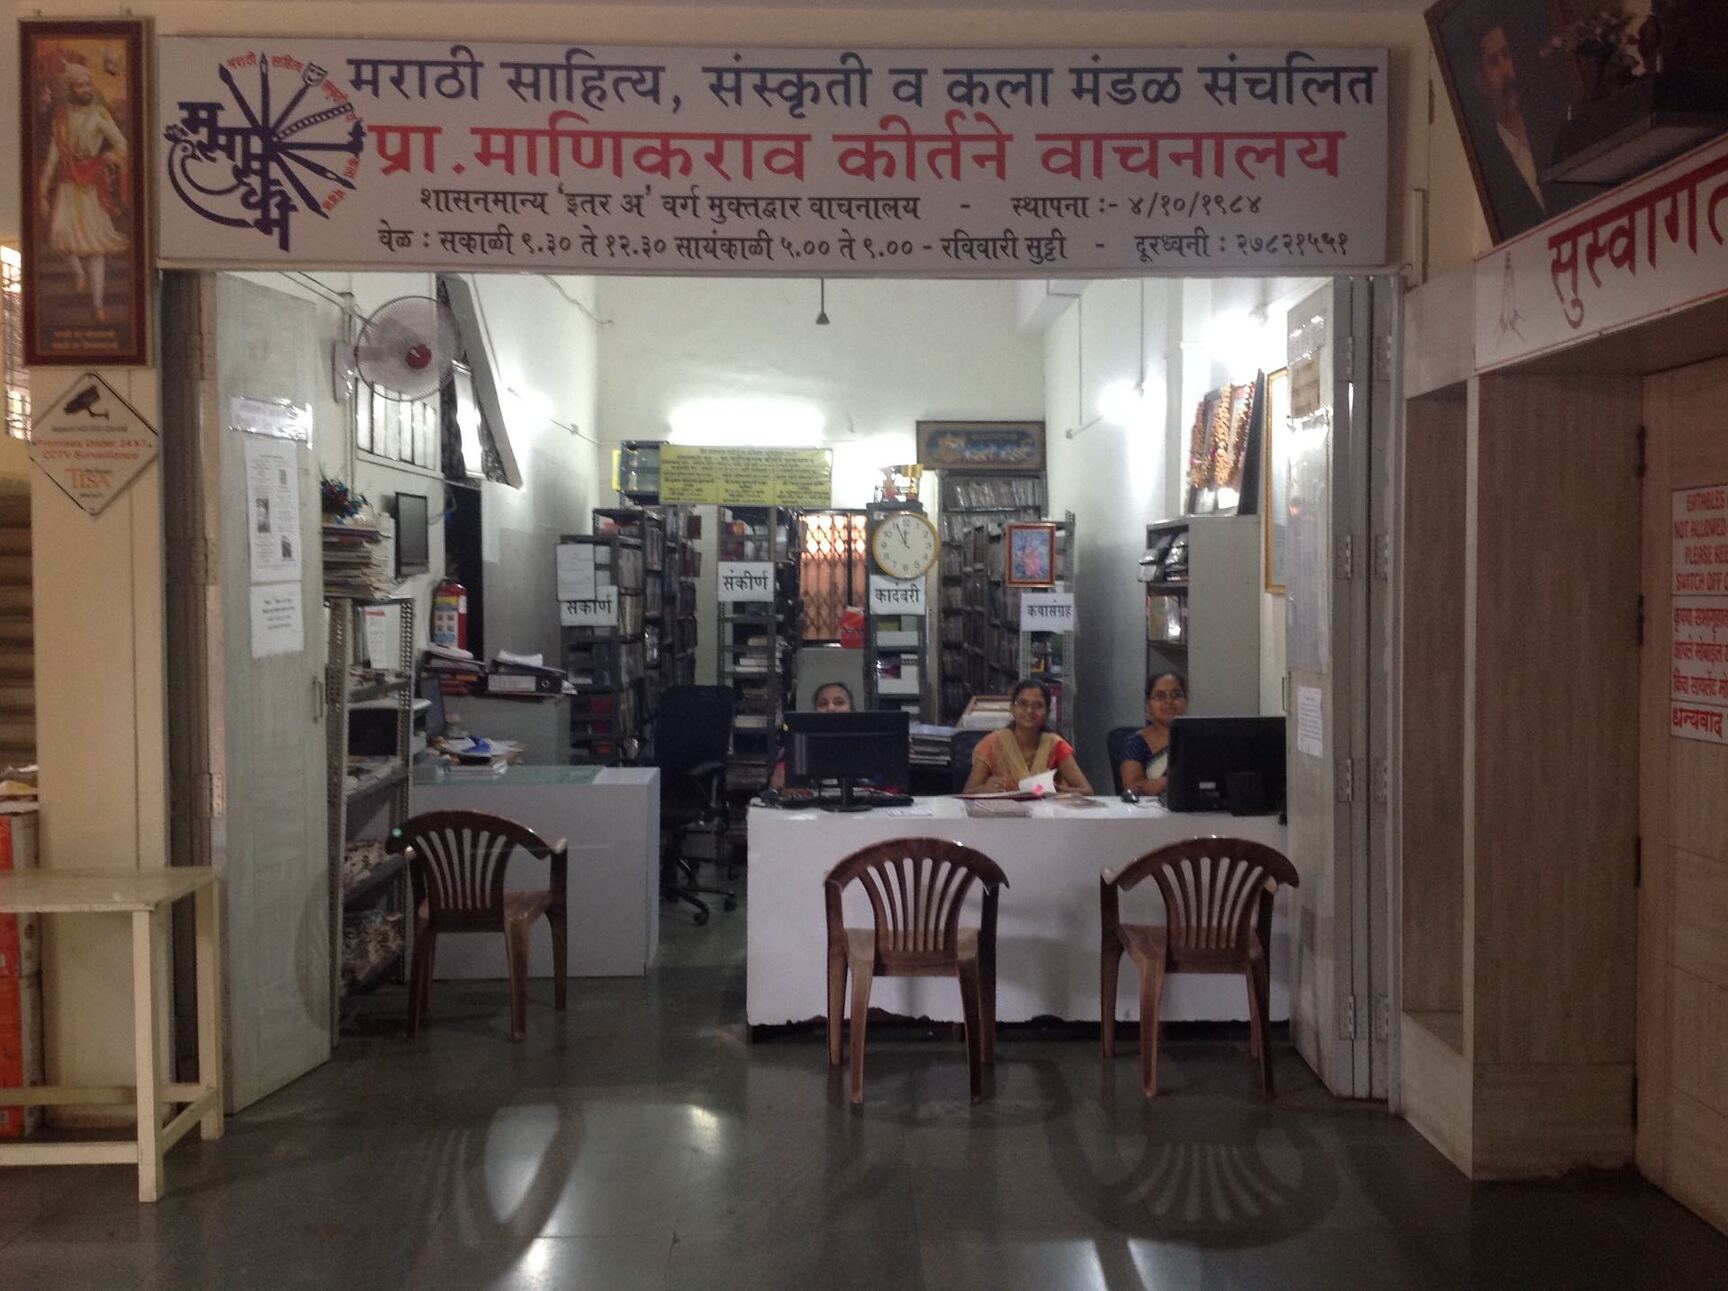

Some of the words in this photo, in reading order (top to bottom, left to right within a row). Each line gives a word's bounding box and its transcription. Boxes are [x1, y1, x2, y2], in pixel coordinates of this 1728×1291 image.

[346, 44, 484, 102] मराठी
[499, 47, 682, 114] साहित्य,
[701, 51, 873, 119] संस्कृती
[887, 67, 929, 109] व
[942, 67, 1054, 110] कला
[1068, 53, 1183, 107] मंडळ
[1197, 50, 1379, 107] संचलित
[831, 108, 1014, 182] कीर्तने
[1035, 131, 1346, 181] वाचनालय
[420, 188, 549, 216] शासनमान्य
[660, 184, 701, 219] वर्ग
[706, 195, 802, 225] मुक्तद्वार
[807, 196, 921, 220] वाचनालय
[1010, 196, 1090, 220] स्थापना
[378, 222, 415, 253] वेळ
[437, 223, 515, 256] सकाळी
[579, 225, 599, 258] ते
[606, 234, 667, 258] १२.३०
[673, 229, 774, 261] सायंकाळी
[837, 228, 856, 261] ते
[939, 228, 1020, 261] रविवारी
[1023, 227, 1067, 265] सुट्टी
[1134, 225, 1210, 263] दूरध्वनी
[722, 568, 769, 591] संकीर्ण
[1672, 707, 1723, 738] धन्यवाद
